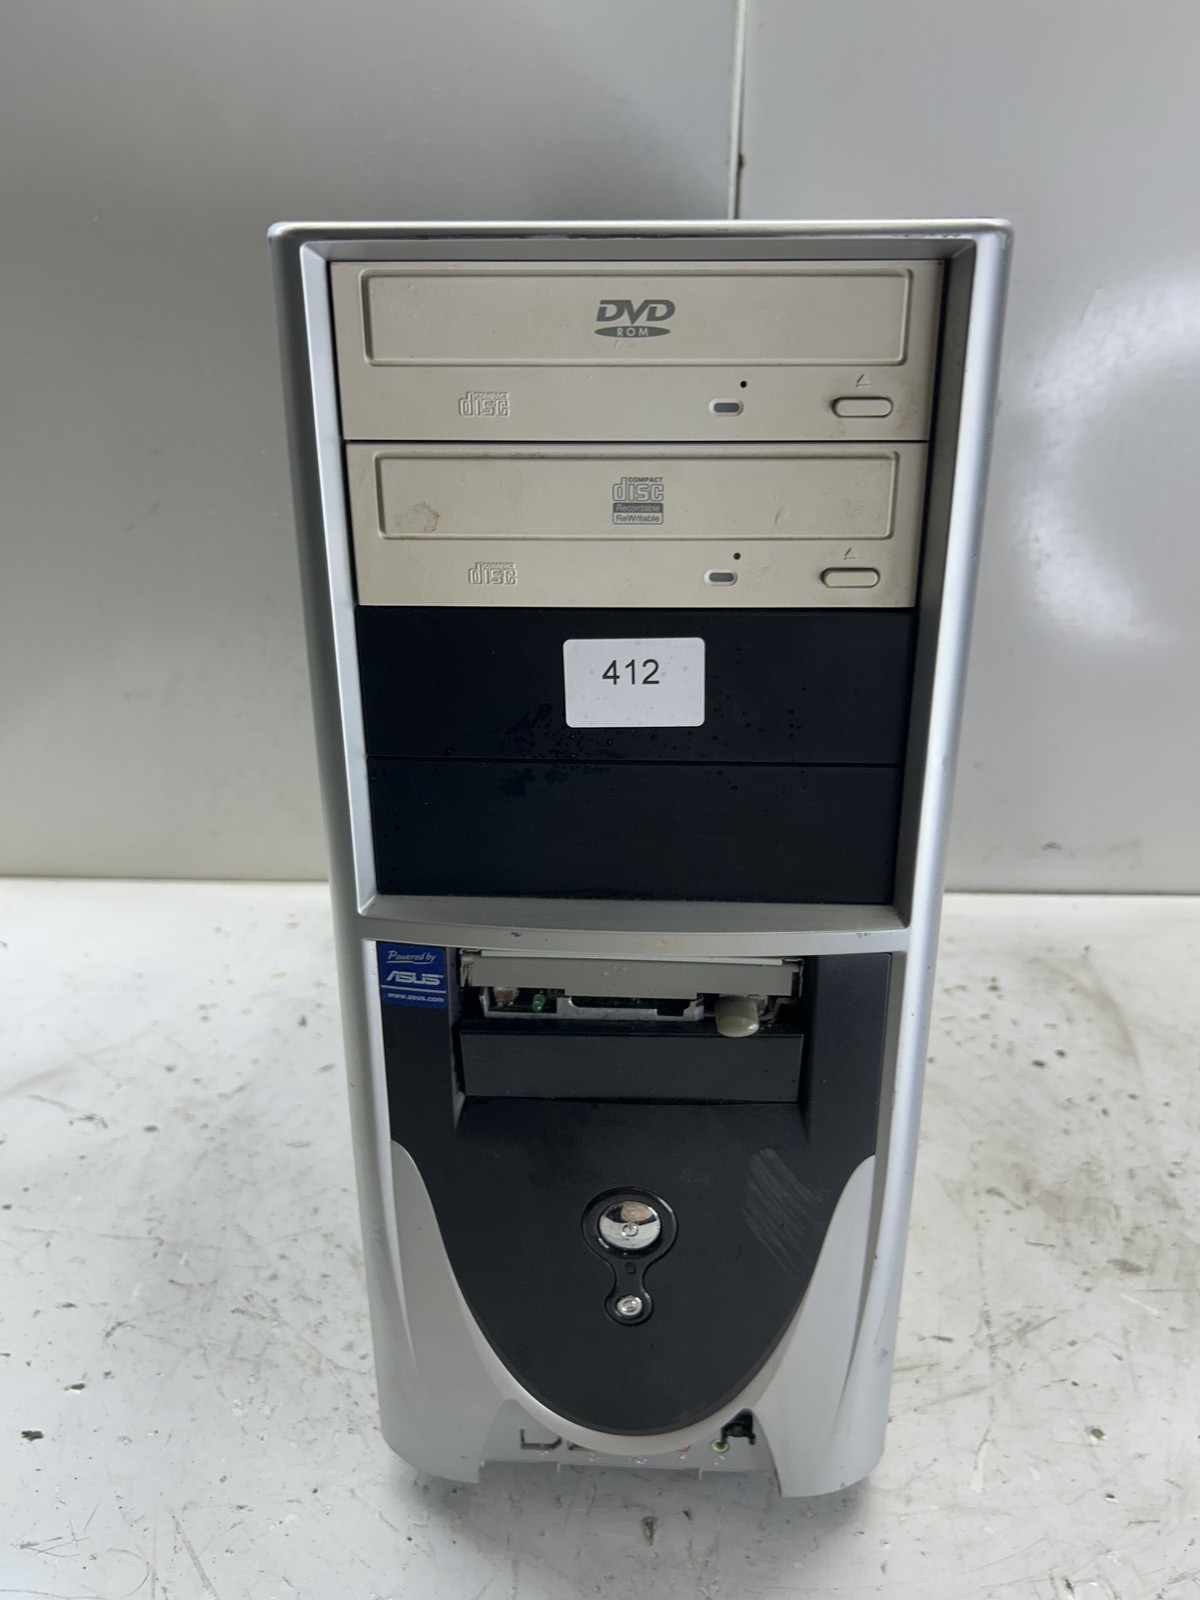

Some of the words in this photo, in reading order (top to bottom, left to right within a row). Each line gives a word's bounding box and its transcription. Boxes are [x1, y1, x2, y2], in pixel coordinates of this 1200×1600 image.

[596, 299, 676, 325] DVD
[616, 327, 649, 337] ROM
[612, 476, 664, 501] disc
[602, 658, 660, 686] 412
[387, 950, 426, 961] Powered
[426, 952, 437, 962] by
[386, 970, 444, 985] ASUS
[388, 992, 445, 1002] www.asus.com
